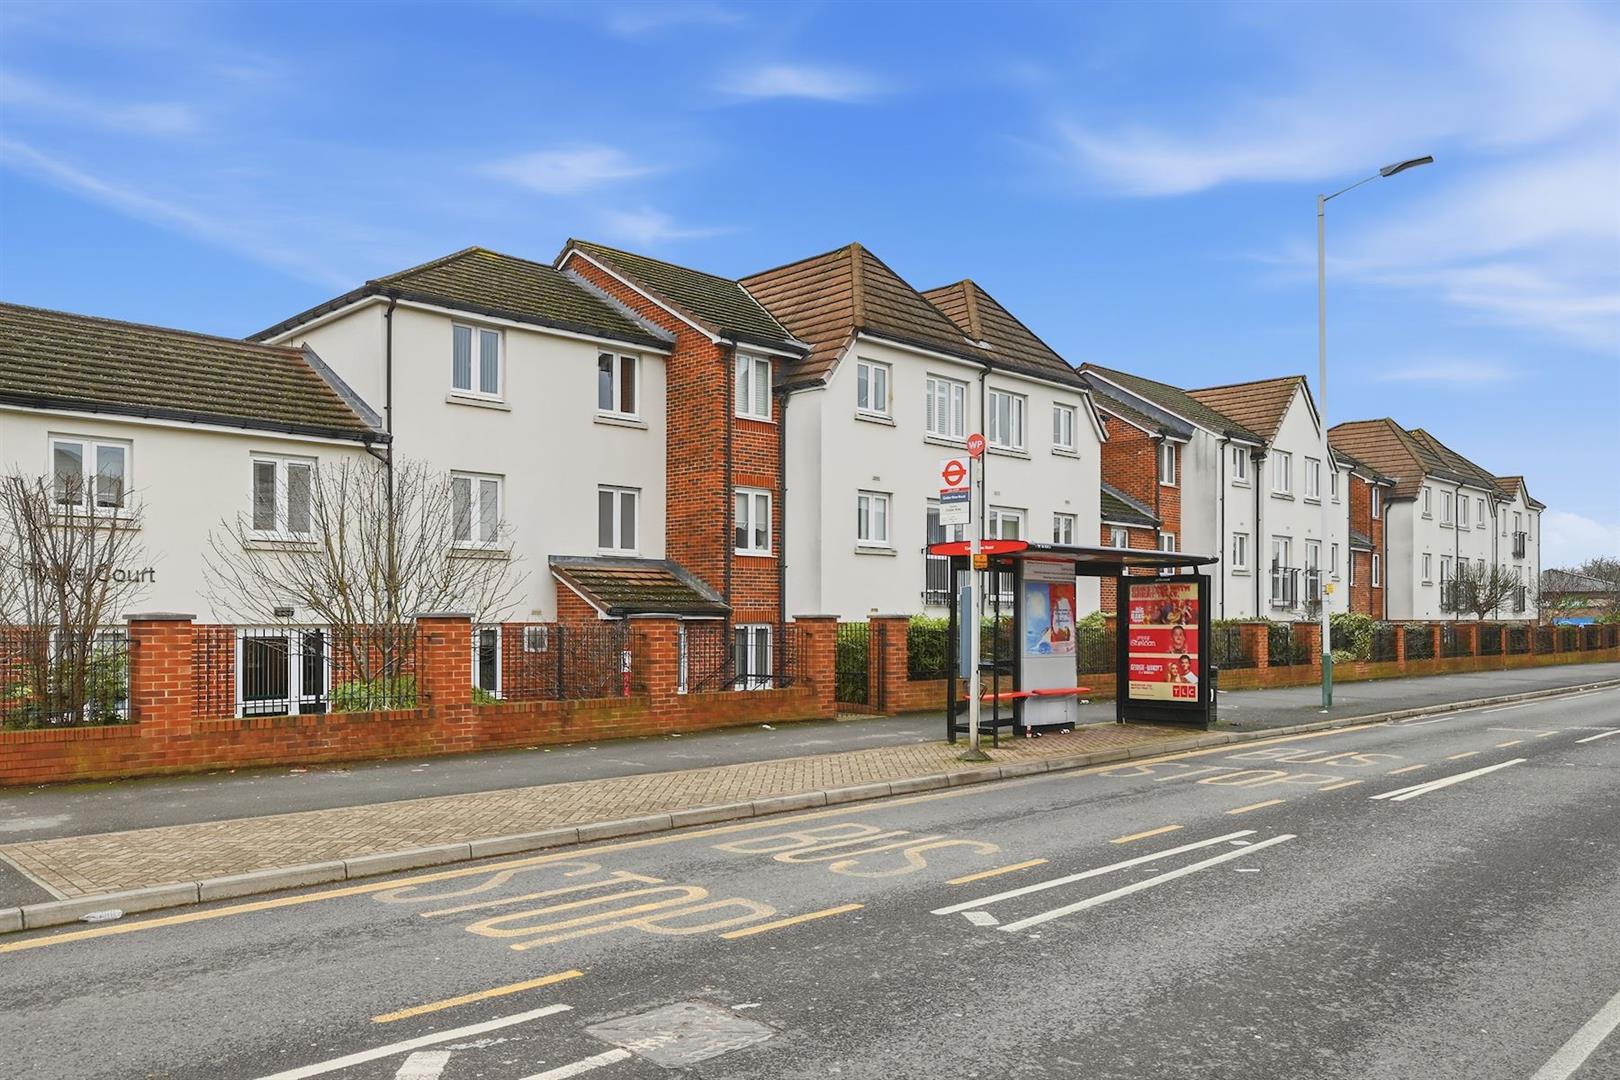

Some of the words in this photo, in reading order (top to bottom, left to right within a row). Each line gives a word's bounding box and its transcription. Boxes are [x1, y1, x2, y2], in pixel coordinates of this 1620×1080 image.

[968, 440, 982, 449] WP
[96, 564, 156, 583] Court
[1174, 688, 1194, 696] TLC
[1224, 747, 1403, 767] BUS
[1097, 762, 1344, 789] STOP
[711, 822, 1001, 878] BUS
[372, 861, 776, 951] STOP
